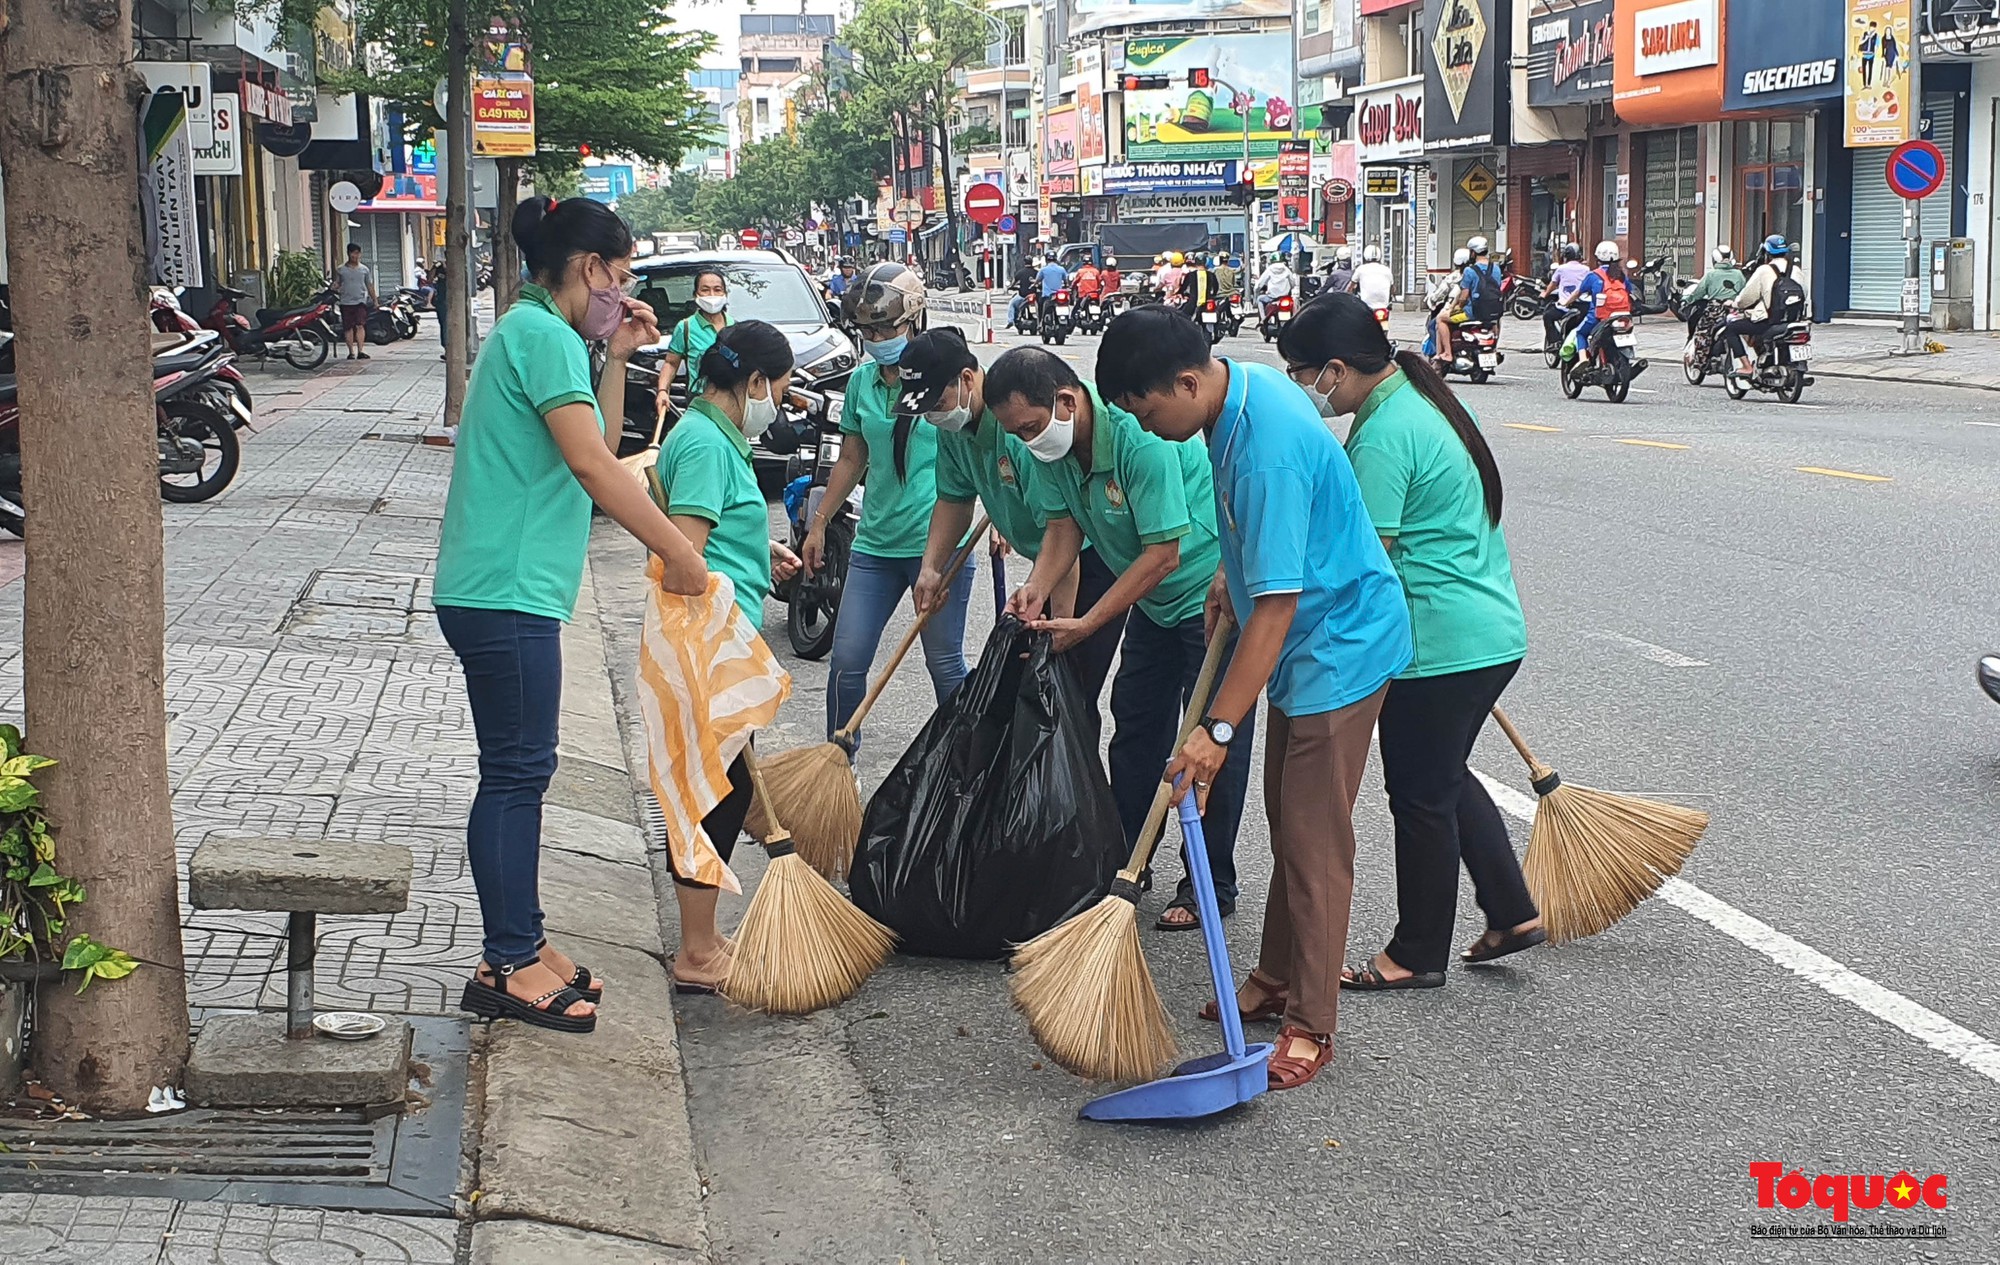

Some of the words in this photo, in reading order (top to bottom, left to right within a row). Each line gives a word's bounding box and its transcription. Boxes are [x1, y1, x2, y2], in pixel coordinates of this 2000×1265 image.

[1127, 42, 1164, 59] Eugica
[1642, 18, 1701, 59] SABLANCA
[1742, 58, 1837, 95] SKECHERS
[478, 107, 502, 119] 6.49
[503, 107, 528, 121] TRIỆU
[1393, 93, 1421, 142] BAG
[155, 151, 166, 205] NGAY
[167, 155, 176, 192] TAY
[1183, 159, 1226, 176] NHẤT
[1164, 192, 1206, 208] THỐNG
